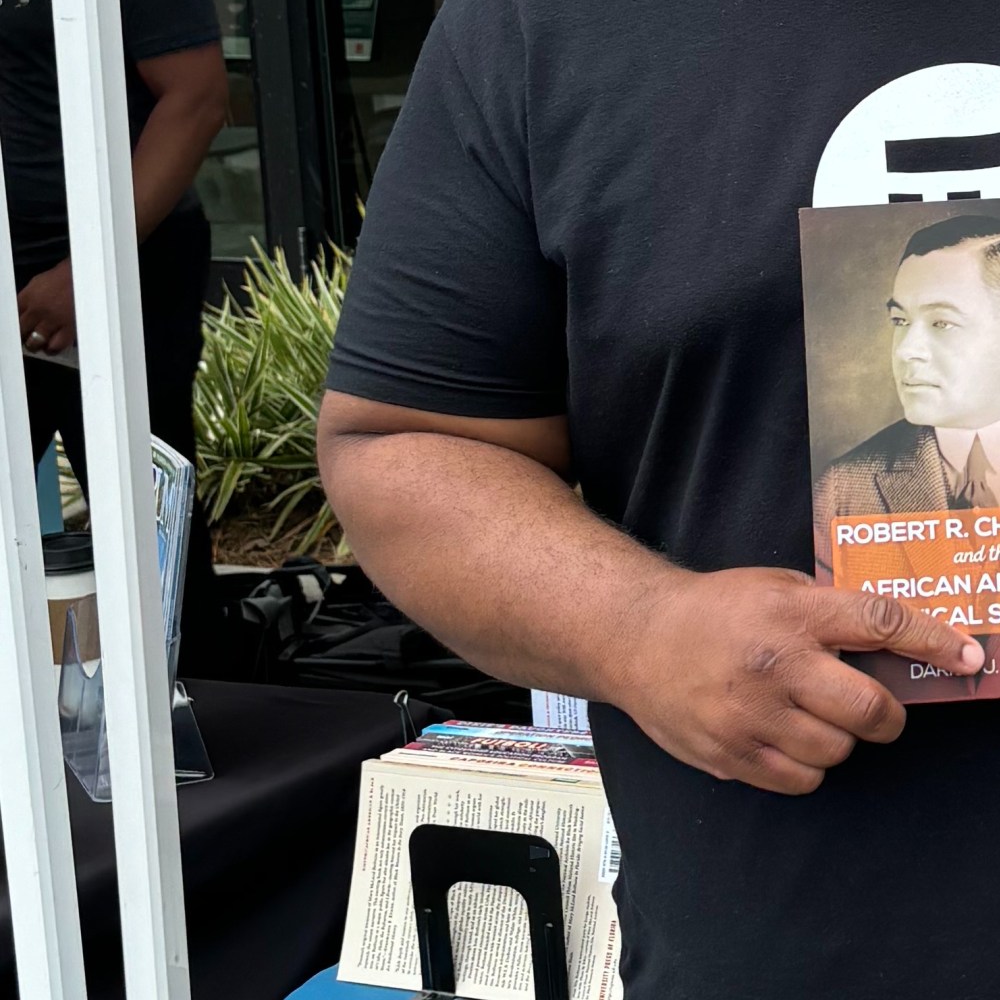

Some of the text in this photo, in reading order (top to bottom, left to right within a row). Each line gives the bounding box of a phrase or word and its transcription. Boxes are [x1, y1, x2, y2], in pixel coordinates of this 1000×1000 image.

[837, 519, 940, 545] ROBERT
[945, 518, 970, 539] R.
[953, 546, 985, 563] and
[861, 574, 972, 599] AFRICAN
[983, 658, 999, 675] J.
[519, 763, 599, 774] CONNECTIO
[608, 919, 616, 941] FLORIDA
